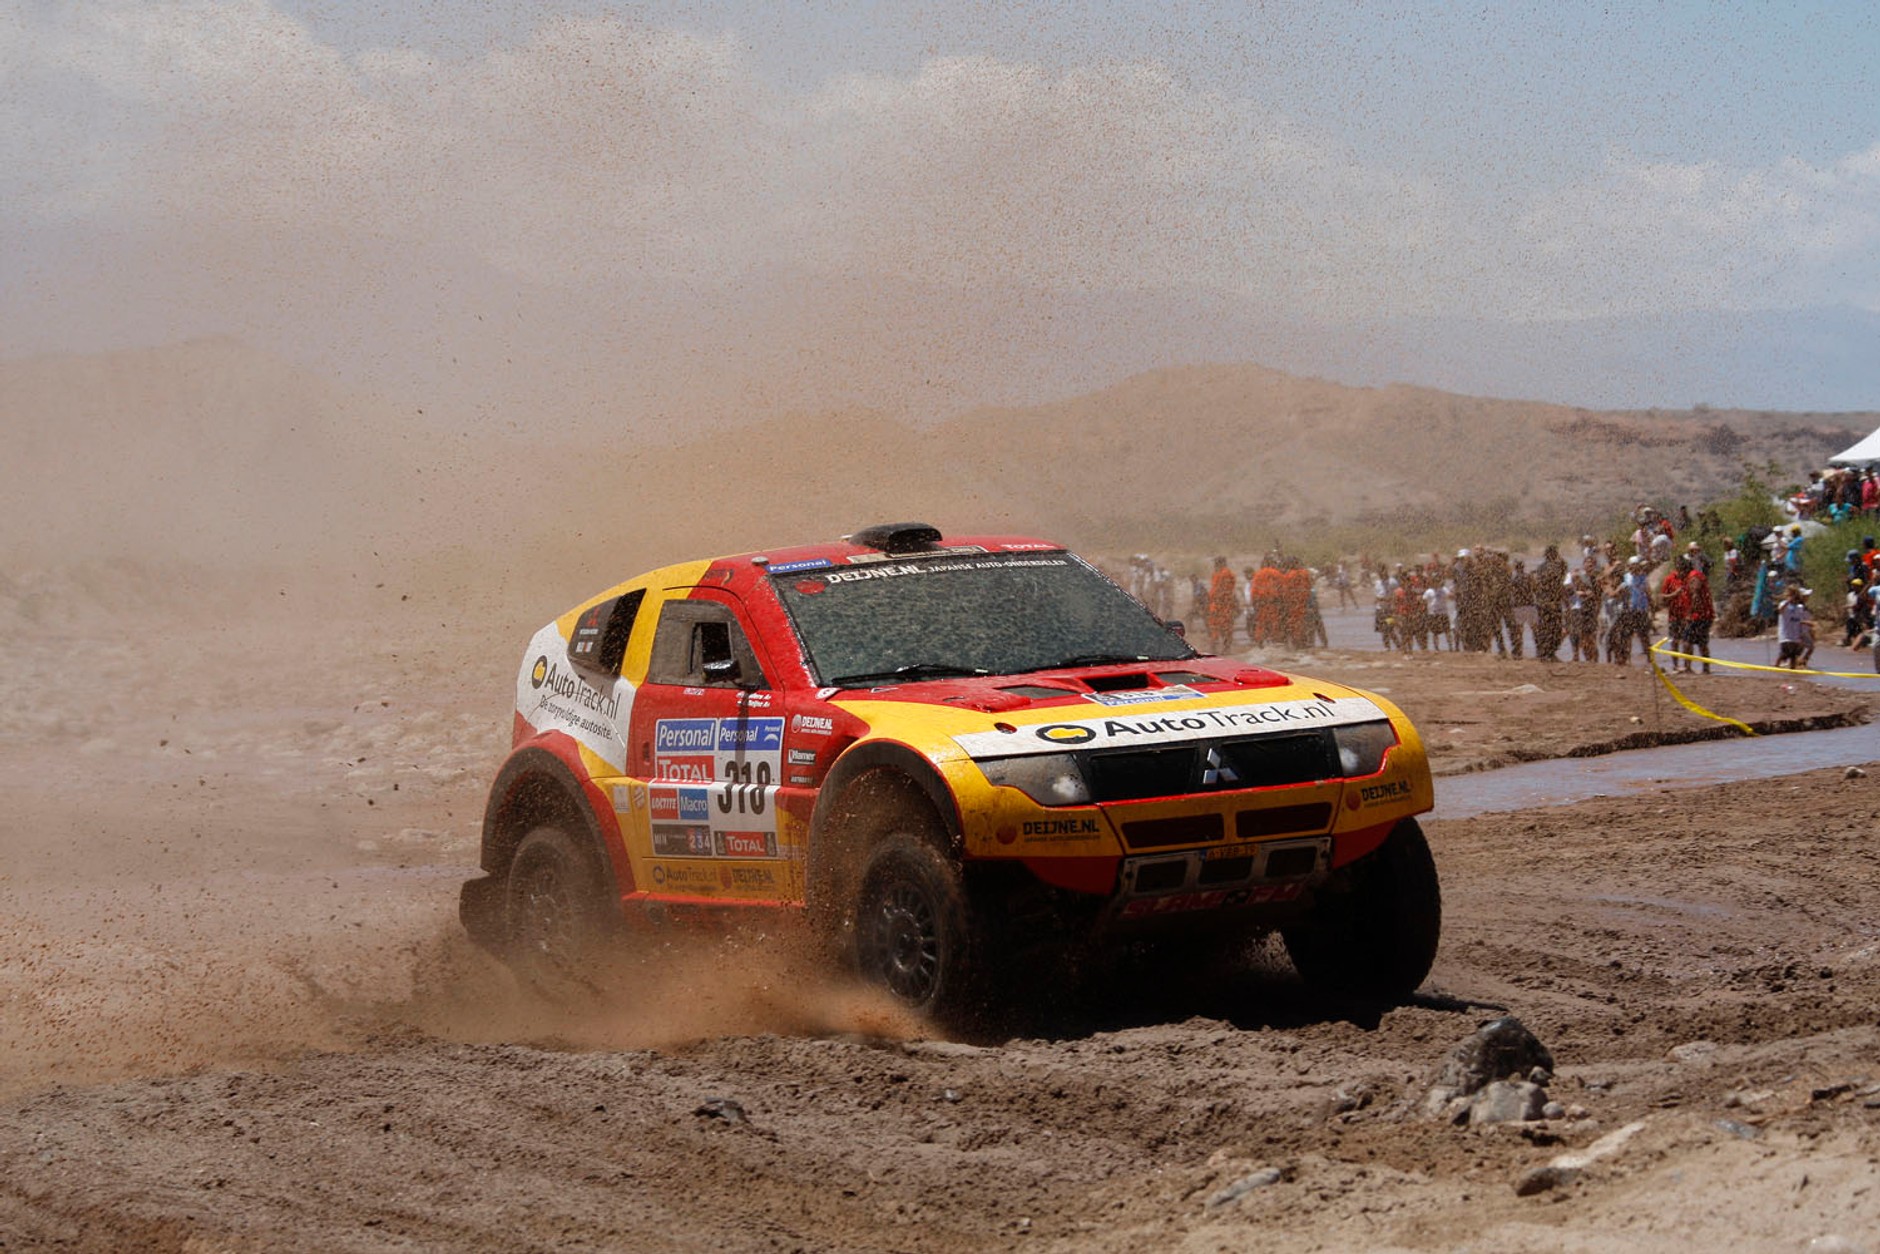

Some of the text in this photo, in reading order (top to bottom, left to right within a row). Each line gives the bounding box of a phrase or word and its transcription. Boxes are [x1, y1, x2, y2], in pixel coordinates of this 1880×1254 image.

[769, 559, 827, 572] Personal
[825, 565, 927, 584] DEIJNE.NL
[929, 563, 975, 572] JAPANSE
[545, 663, 621, 720] AutoTrack.nl
[1105, 702, 1335, 737] AutoTrack.nl
[658, 723, 714, 748] Personal
[720, 726, 759, 742] Personal
[659, 760, 713, 783] TOTAL
[680, 796, 708, 812] Macro
[1023, 819, 1100, 835] DEIJNE.NL
[726, 836, 765, 852] TOTAL
